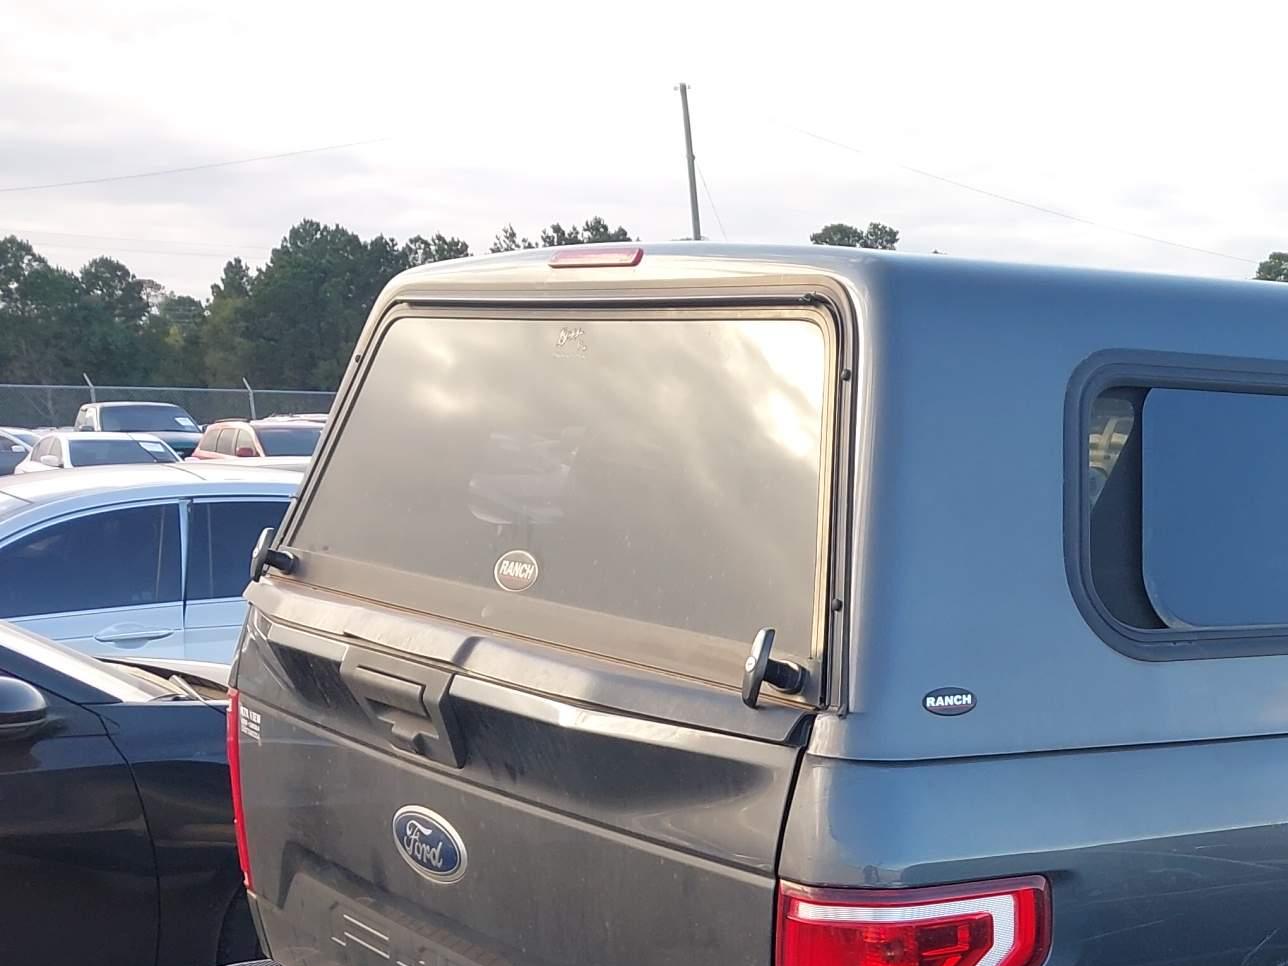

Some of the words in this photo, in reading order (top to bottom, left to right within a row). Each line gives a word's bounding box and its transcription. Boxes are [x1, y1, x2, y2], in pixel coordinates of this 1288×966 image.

[500, 560, 534, 580] RANCH
[926, 694, 972, 707] RANCH
[404, 820, 443, 868] Ford
